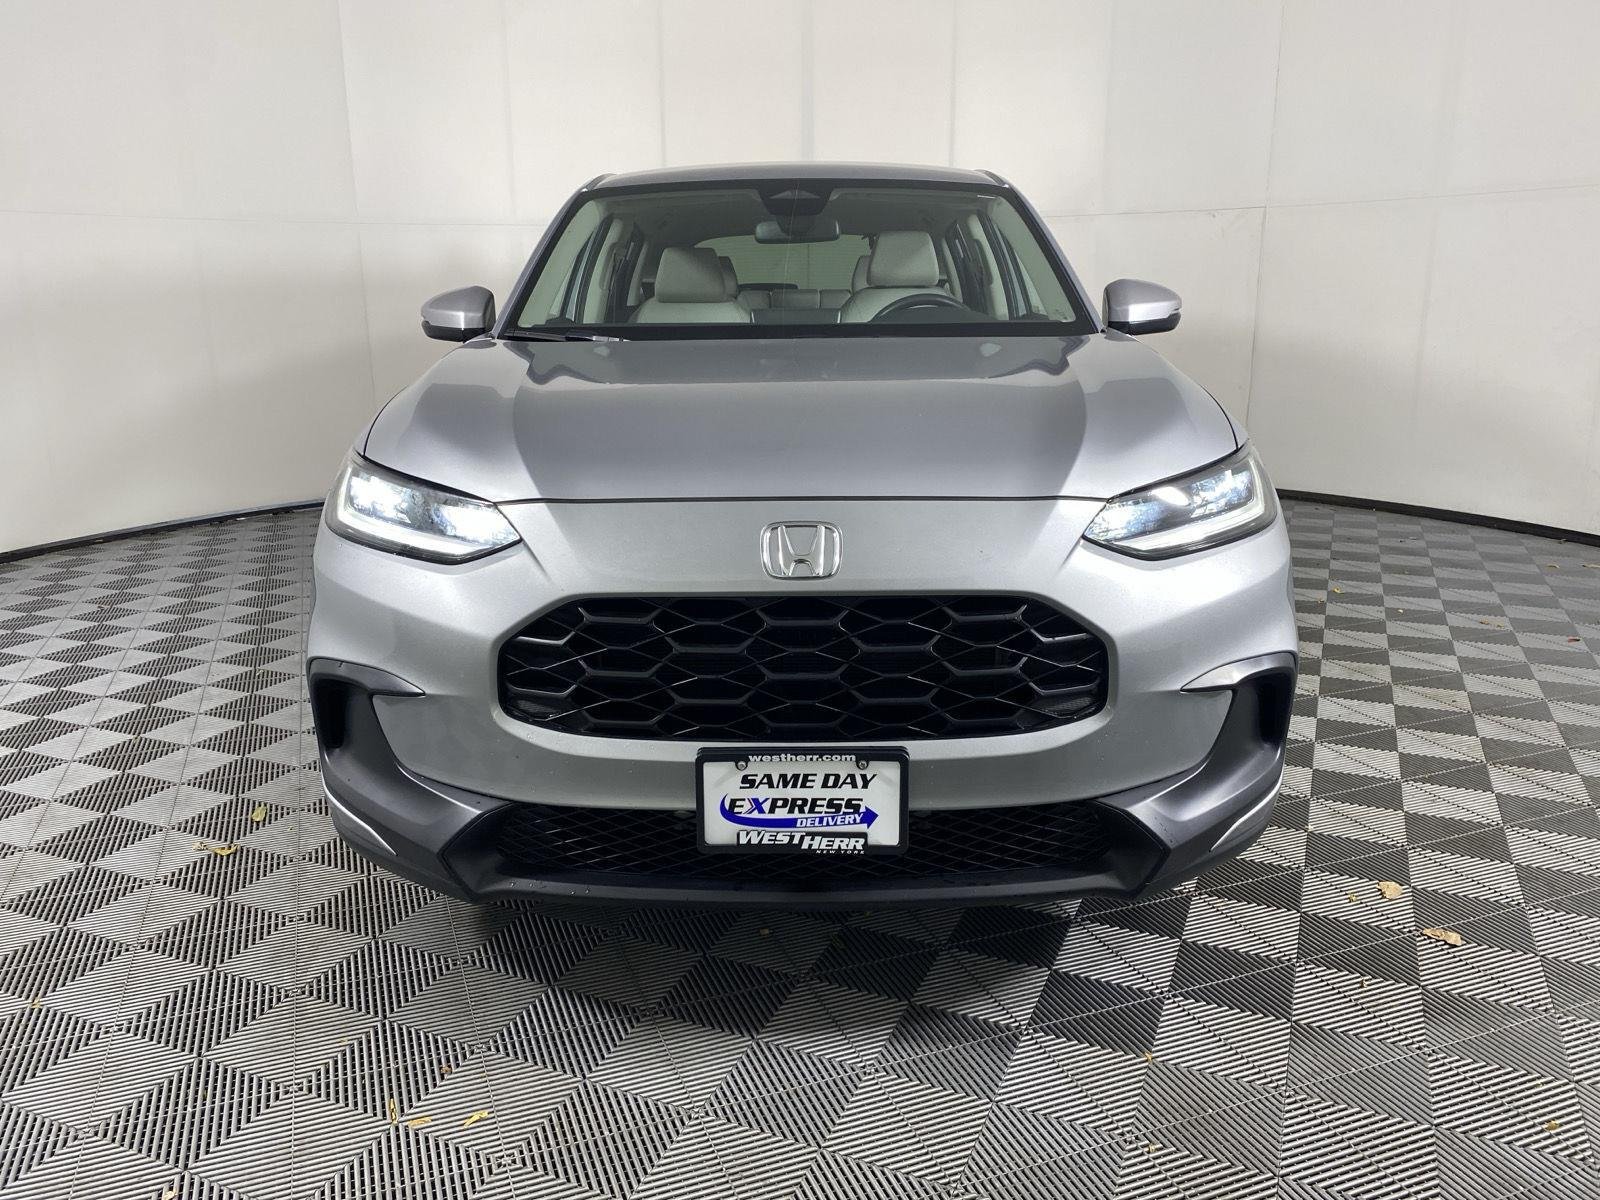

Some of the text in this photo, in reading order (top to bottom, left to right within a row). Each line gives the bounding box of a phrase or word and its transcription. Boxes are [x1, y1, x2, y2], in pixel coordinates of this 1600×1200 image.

[748, 753, 857, 763] westherr.com
[740, 773, 877, 789] SAME DAY
[727, 797, 864, 815] EXPRESS
[796, 814, 864, 828] DELIVERY
